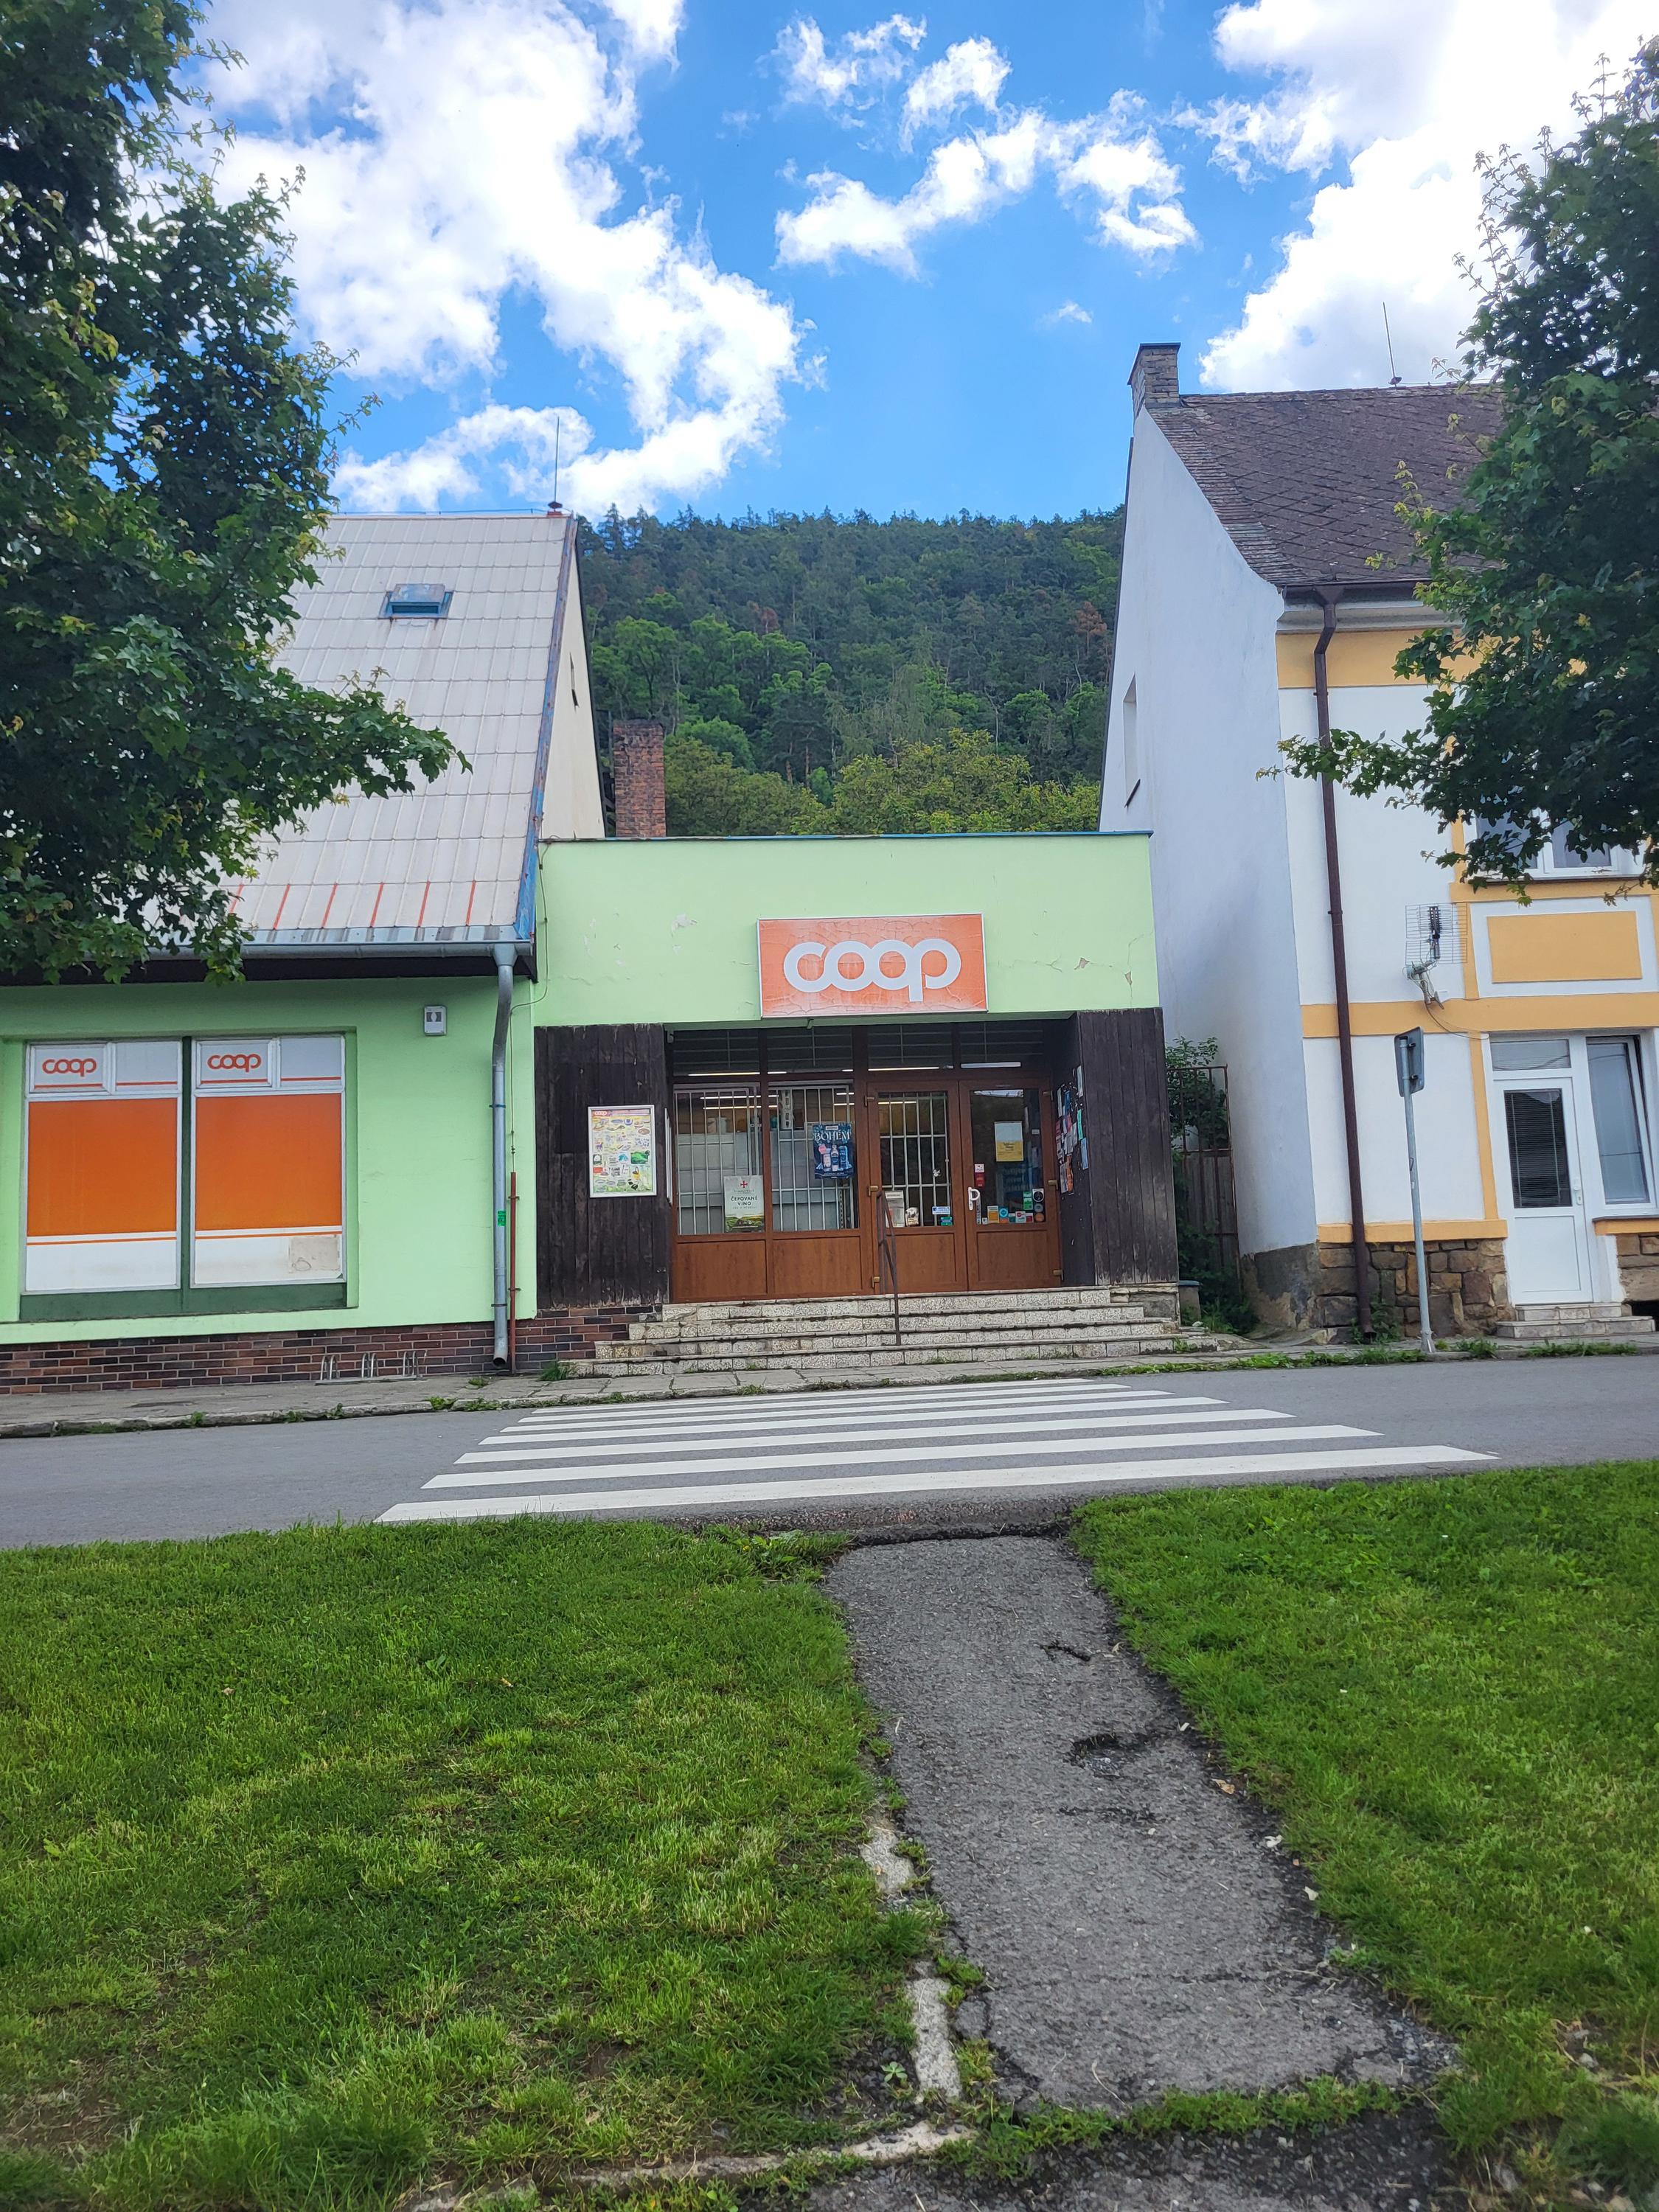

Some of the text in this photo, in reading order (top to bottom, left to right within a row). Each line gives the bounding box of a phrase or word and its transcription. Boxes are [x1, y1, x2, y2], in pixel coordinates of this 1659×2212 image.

[783, 938, 961, 1002] coop
[41, 1057, 97, 1077] coop
[206, 1054, 262, 1073] coop
